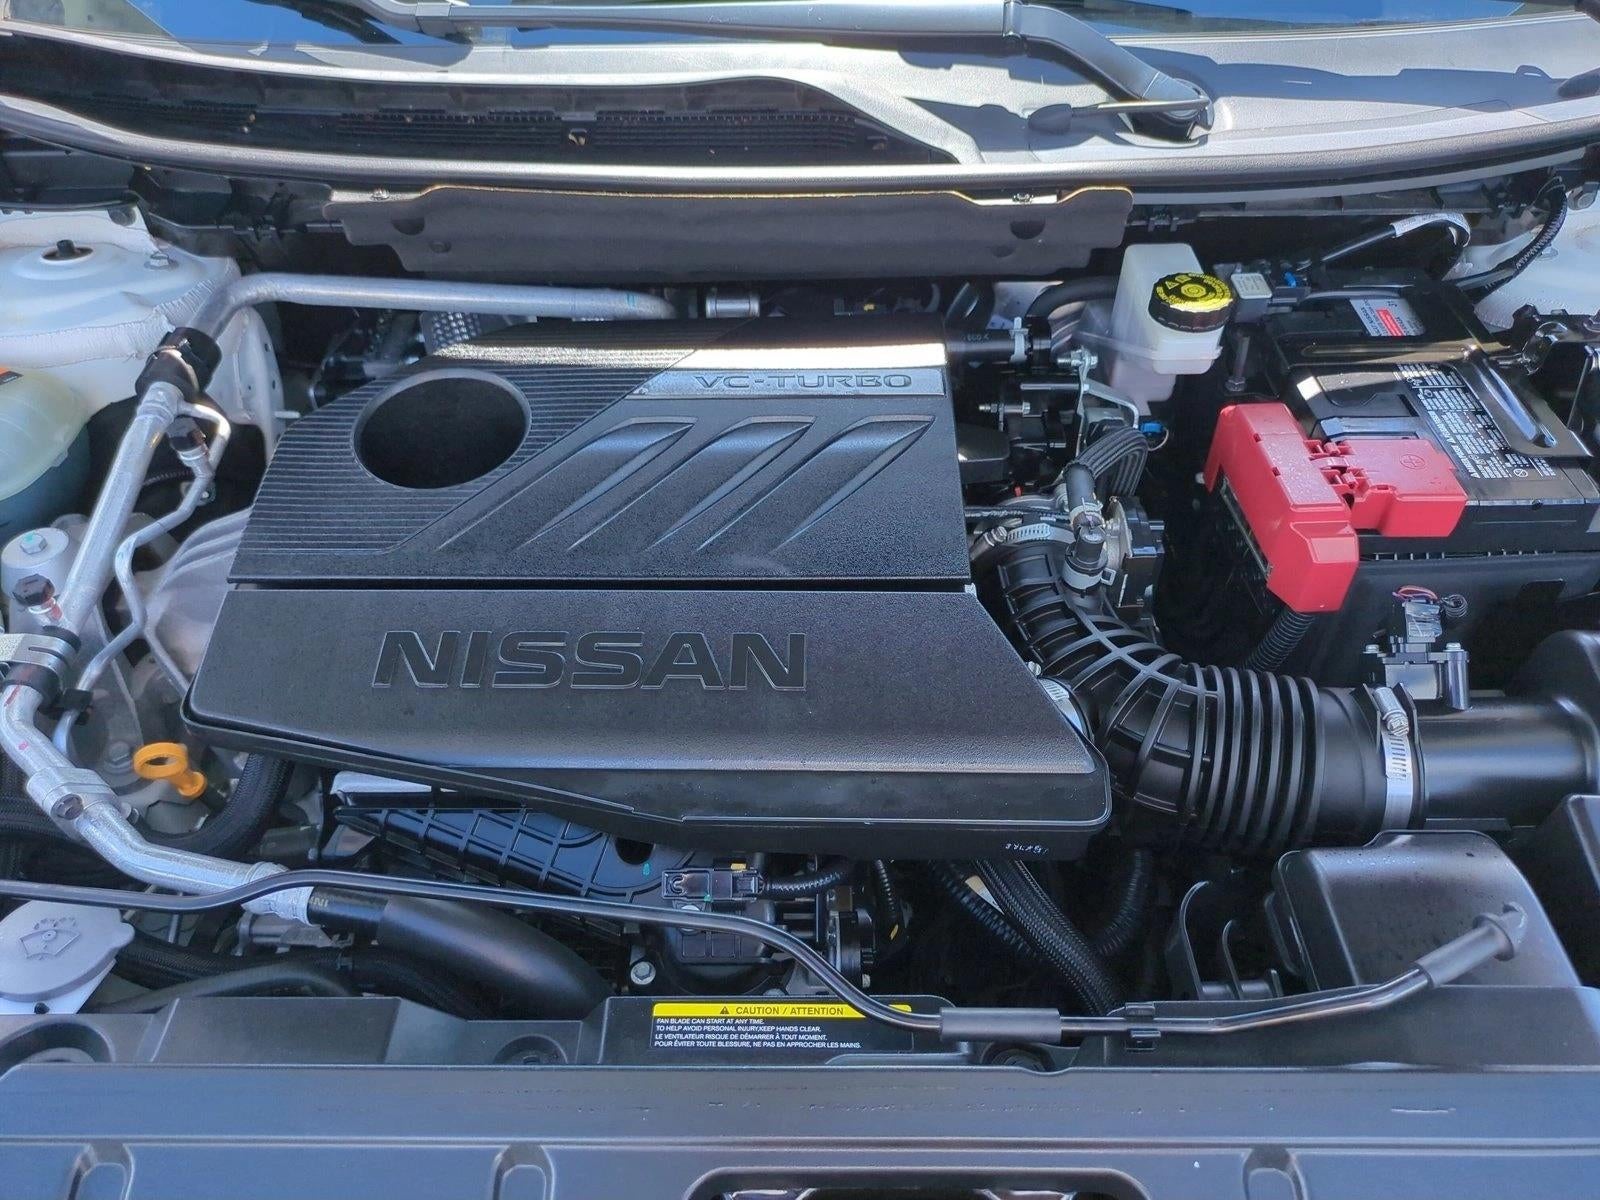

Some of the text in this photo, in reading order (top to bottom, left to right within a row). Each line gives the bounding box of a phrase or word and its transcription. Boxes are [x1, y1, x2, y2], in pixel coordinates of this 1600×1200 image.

[695, 374, 912, 388] VC-TURBO
[372, 631, 806, 690] NISSAN
[736, 1007, 779, 1015] CAUTION
[789, 1007, 844, 1015] ATTENTION
[739, 1032, 775, 1040] DÉMARRER
[673, 1039, 695, 1047] ÉVITER
